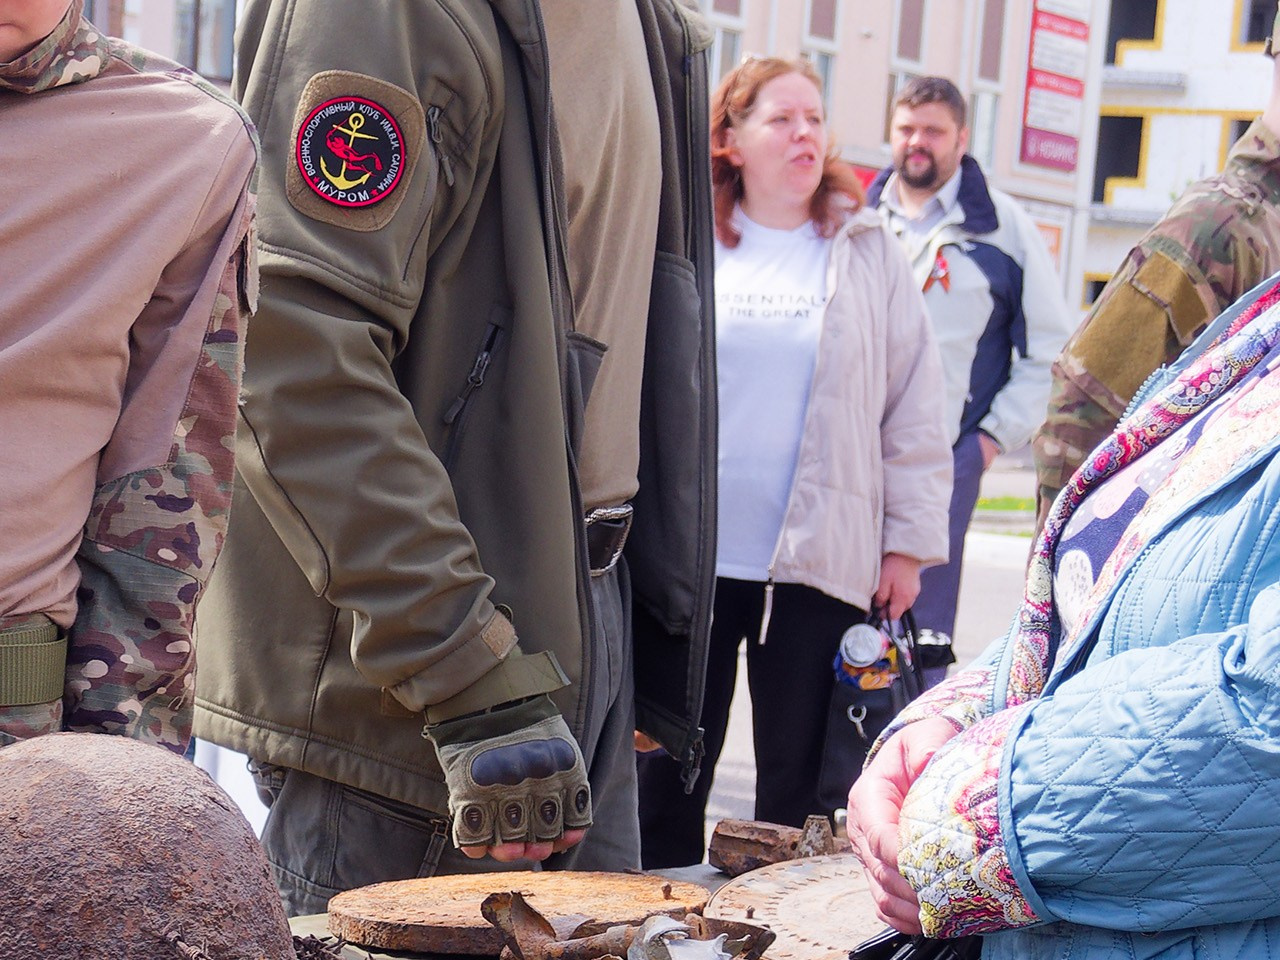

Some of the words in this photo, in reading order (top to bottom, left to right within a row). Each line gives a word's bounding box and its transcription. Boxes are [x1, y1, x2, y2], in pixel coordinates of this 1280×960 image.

[301, 101, 355, 177] ВОЕННО-СПОРТИВНЫЙ
[359, 104, 381, 120] КЛУБ
[317, 180, 370, 202] МУРОМ
[720, 294, 826, 307] SSENTIAL
